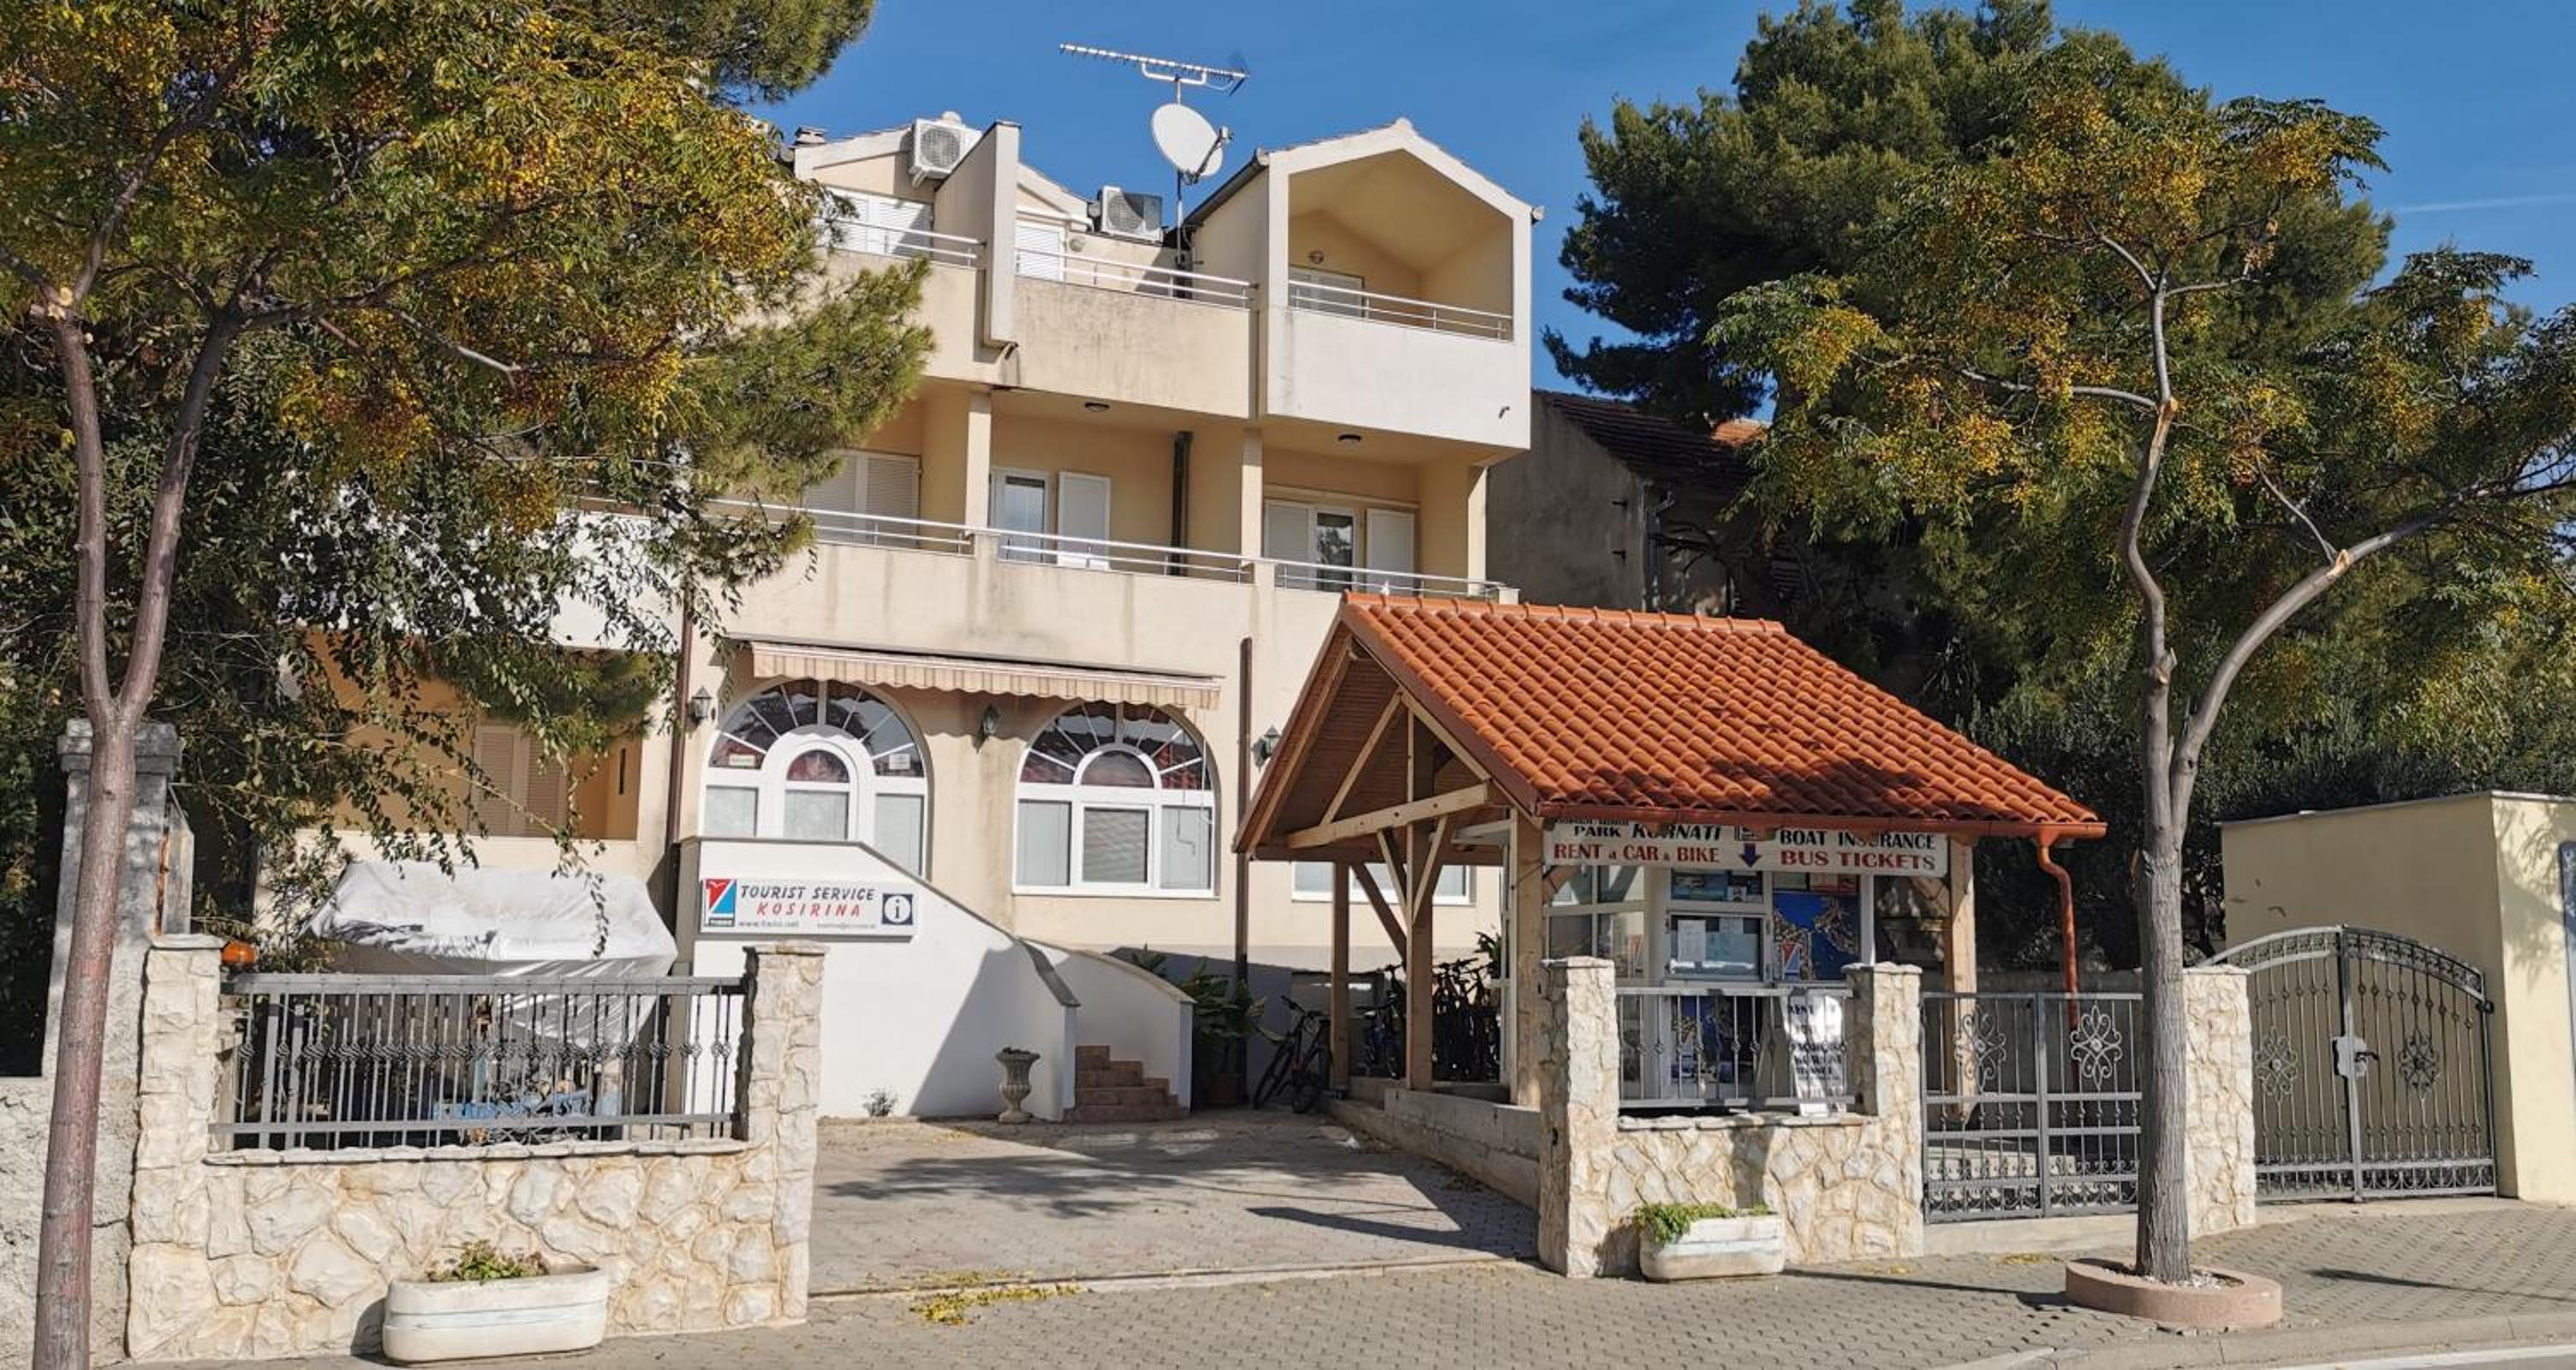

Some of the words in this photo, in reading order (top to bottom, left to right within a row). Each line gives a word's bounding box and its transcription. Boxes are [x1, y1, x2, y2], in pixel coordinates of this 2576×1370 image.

[1574, 825, 1622, 838] PARK
[1632, 823, 1722, 840] KRNATI
[1780, 829, 1828, 846] BOAT
[1553, 844, 1603, 859] RENT
[1623, 844, 1659, 861] CAR
[1677, 846, 1720, 863] BIKE
[1780, 850, 1829, 866] BUS
[1838, 852, 1935, 870] TICKETS
[741, 885, 806, 899] TOURIST
[811, 887, 876, 901] SERVICE
[756, 902, 861, 917] KOSIRINA
